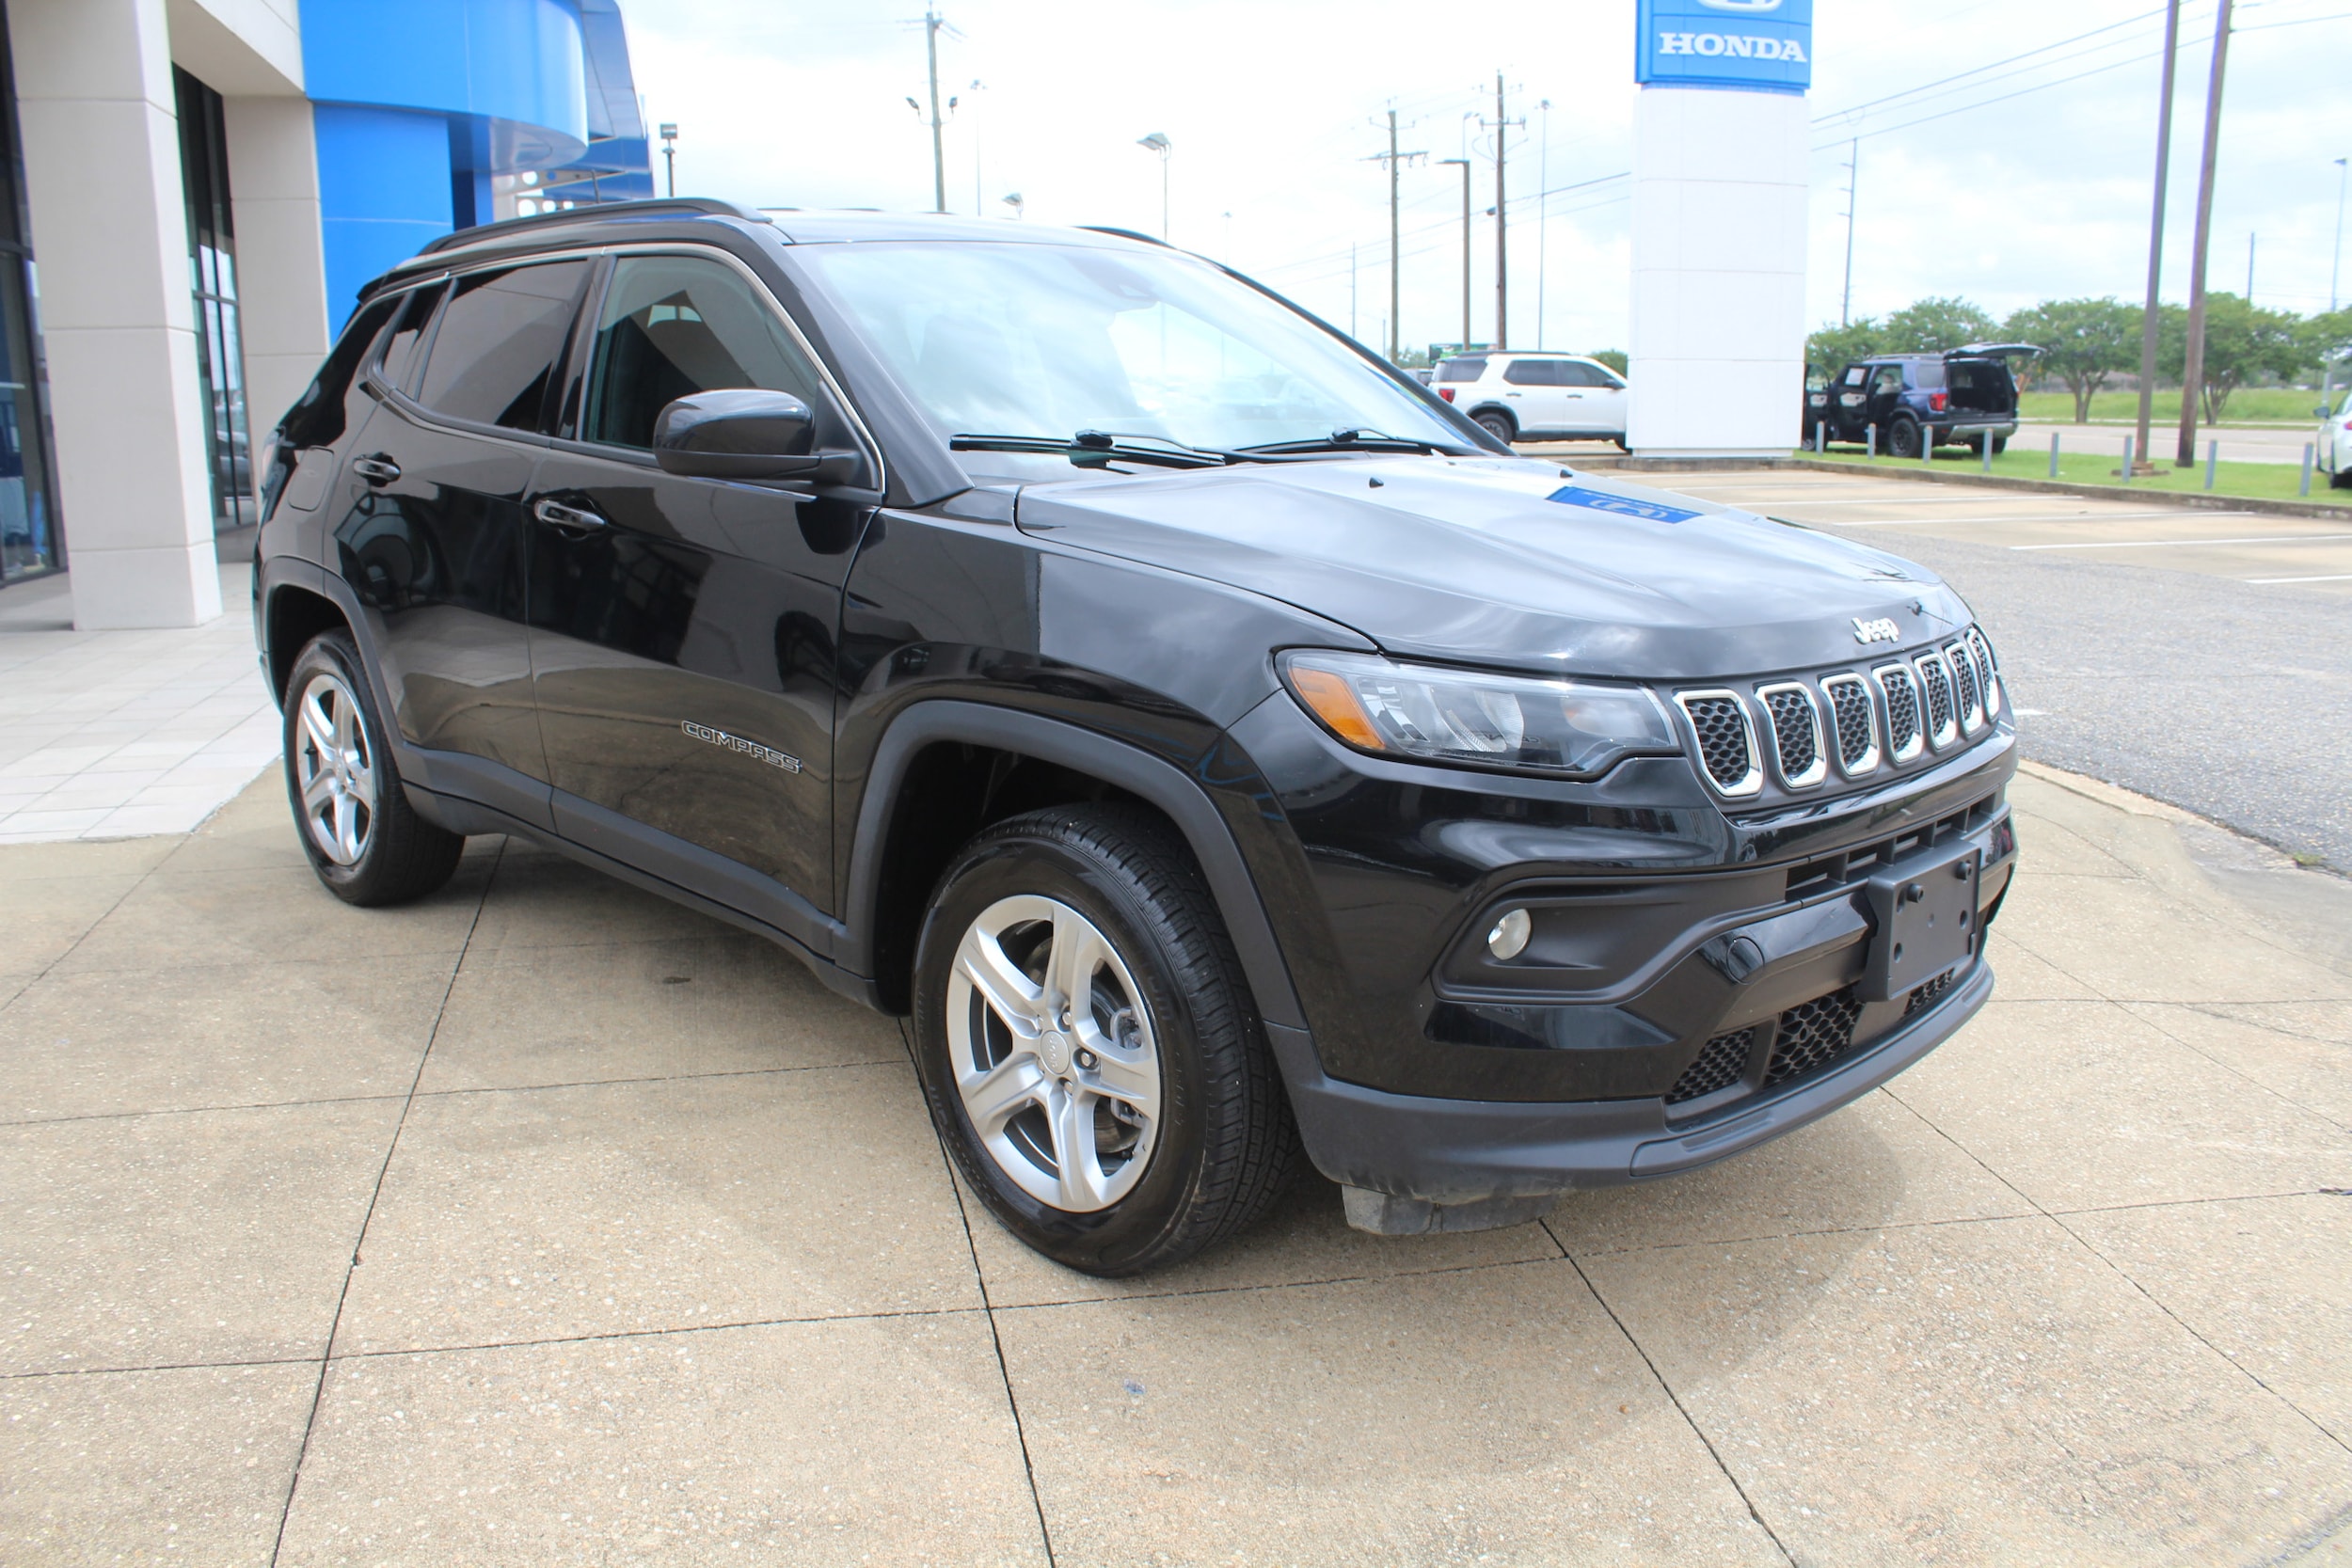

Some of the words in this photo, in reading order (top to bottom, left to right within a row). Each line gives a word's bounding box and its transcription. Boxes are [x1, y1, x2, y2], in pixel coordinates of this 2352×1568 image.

[1659, 32, 1807, 62] HONDA
[1851, 617, 1899, 644] Jeep
[681, 720, 802, 774] COMPASS
